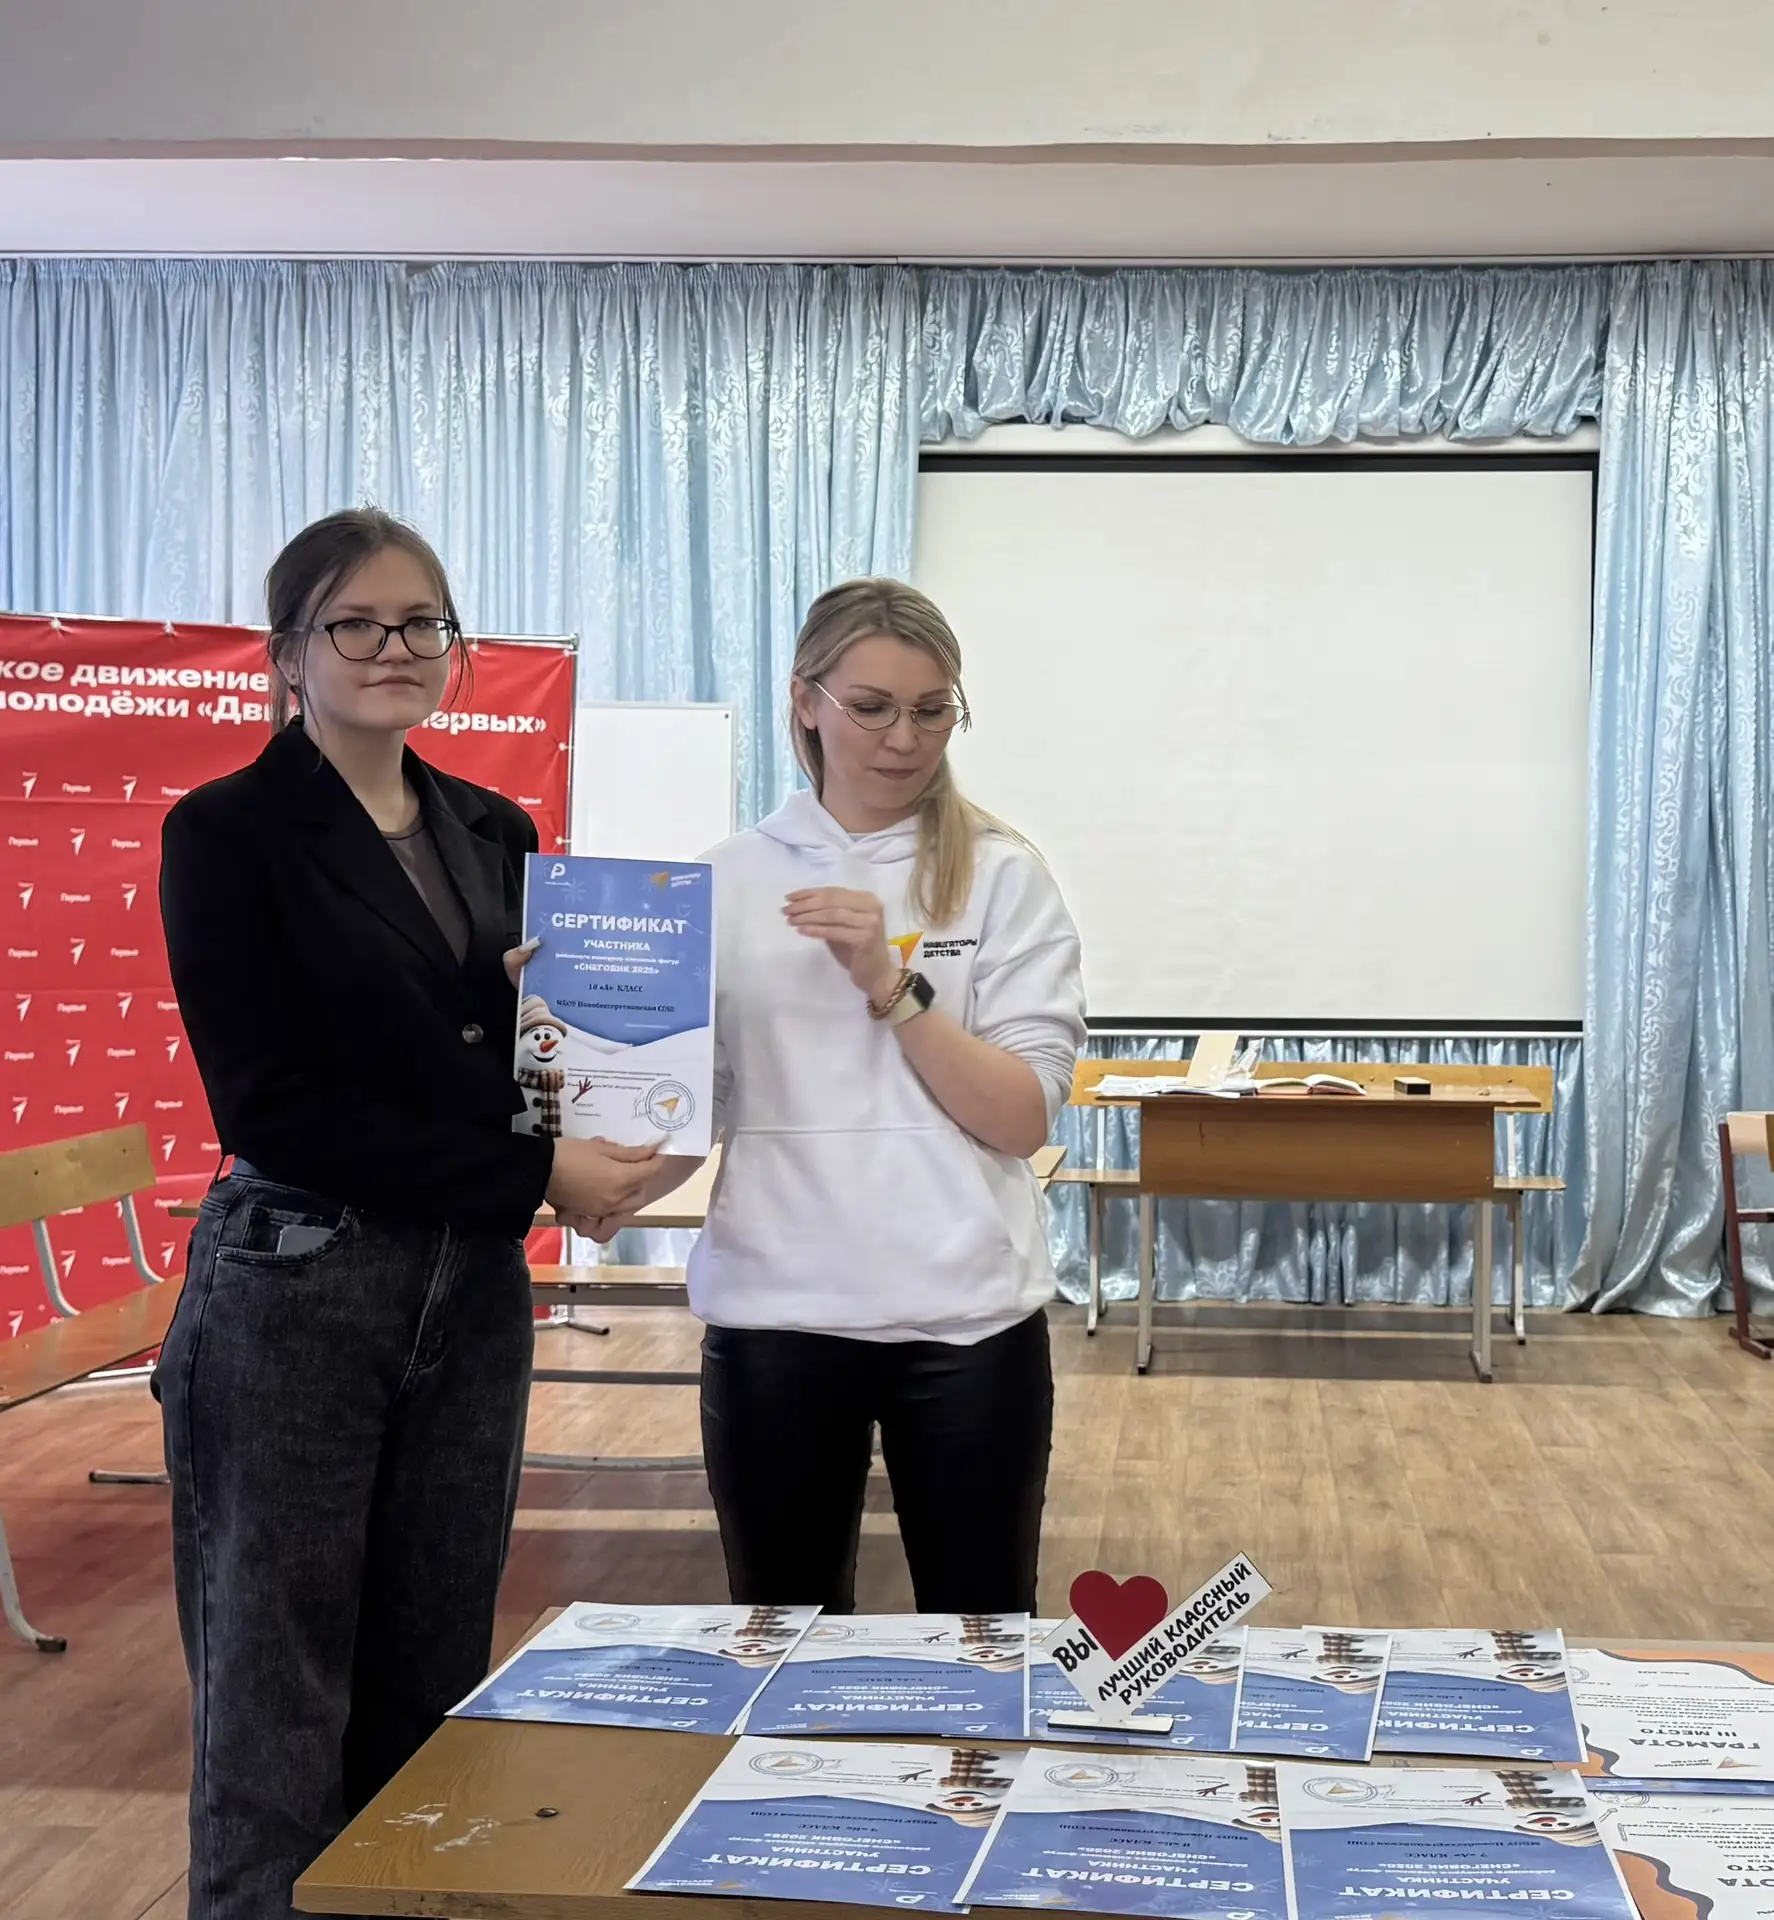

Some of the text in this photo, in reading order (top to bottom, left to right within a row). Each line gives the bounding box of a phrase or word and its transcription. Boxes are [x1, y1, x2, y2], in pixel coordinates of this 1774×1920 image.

[71, 664, 270, 692] движение
[551, 912, 687, 934] СЕРТИФИКАТ
[583, 939, 650, 951] УЧАСТНИКА
[617, 985, 644, 993] КЛАСС
[1097, 1561, 1253, 1701] ЛУЧШИЙ КЛАССНЫЙ
[1052, 1628, 1099, 1673] ВЫ
[1118, 1592, 1251, 1706] РУКОВОДИТЕЛЬ
[578, 1682, 669, 1693] УЧАСТНИКА
[516, 1689, 708, 1706] СЕРТИФИКАТ
[787, 1703, 984, 1711] СЕРТИФИКАТ
[1387, 1711, 1483, 1721] УЧАСТНИКА
[1639, 1728, 1710, 1736] МЕСТО
[1628, 1738, 1761, 1750] ГРАМОТА
[771, 1846, 881, 1858] УЧАСТНИКА
[701, 1853, 932, 1875] СЕРТИФИКАТ
[1088, 1860, 1199, 1873] УЧАСТНИКА
[1021, 1867, 1255, 1892] СЕРТИФИКАТ
[1396, 1876, 1512, 1884] УЧАСТНИКА
[1338, 1886, 1575, 1900] СЕРТИФИКАТ
